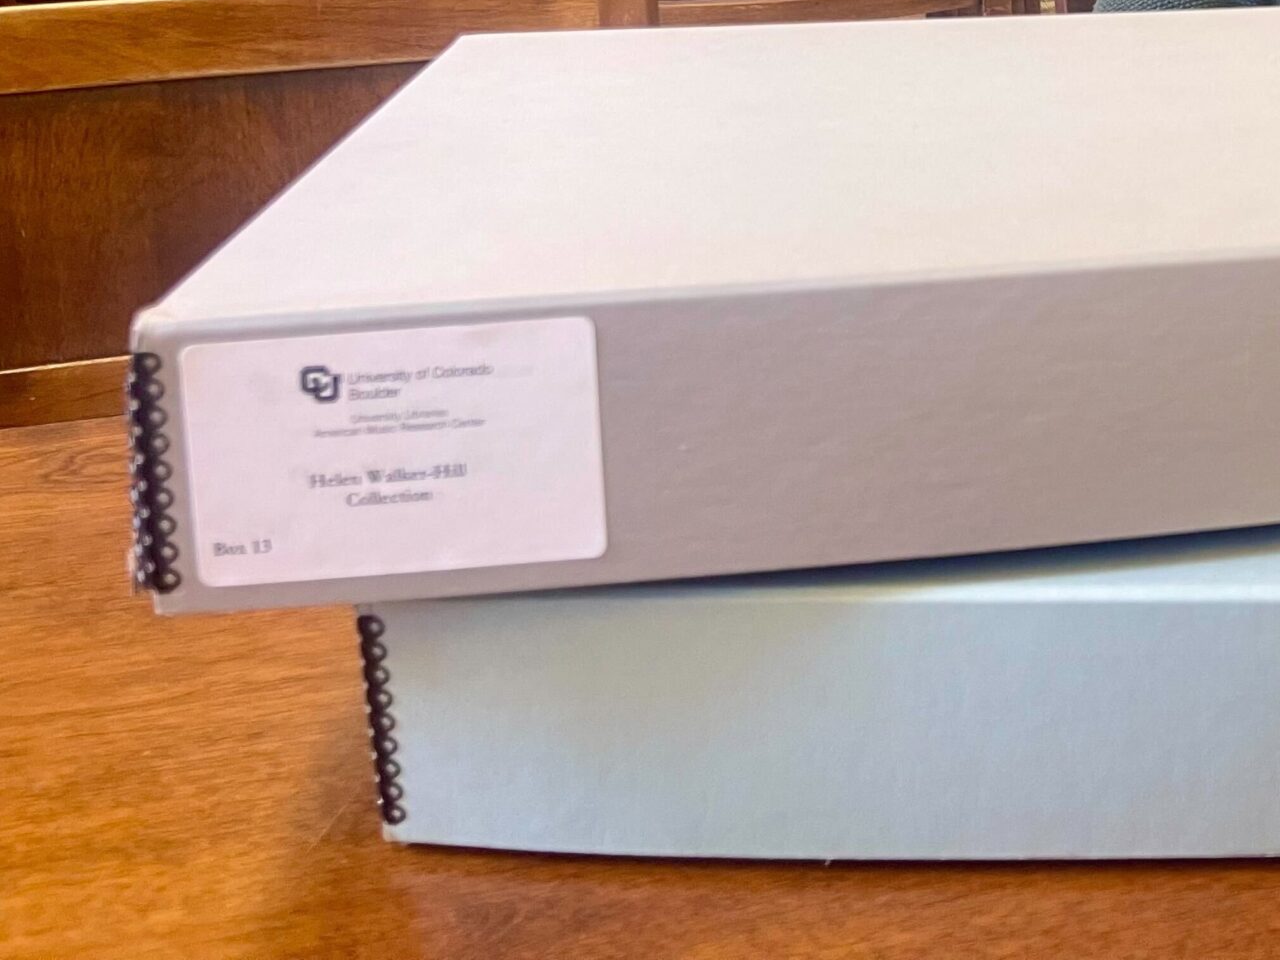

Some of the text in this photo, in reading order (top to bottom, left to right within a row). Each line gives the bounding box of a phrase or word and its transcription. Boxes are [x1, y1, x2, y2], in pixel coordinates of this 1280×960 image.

[347, 364, 494, 385] University of Colorado
[349, 388, 401, 401] Boulder
[308, 463, 468, 489] Helen Walker-Hill
[346, 489, 434, 508] Collection
[213, 539, 273, 557] Box 13
